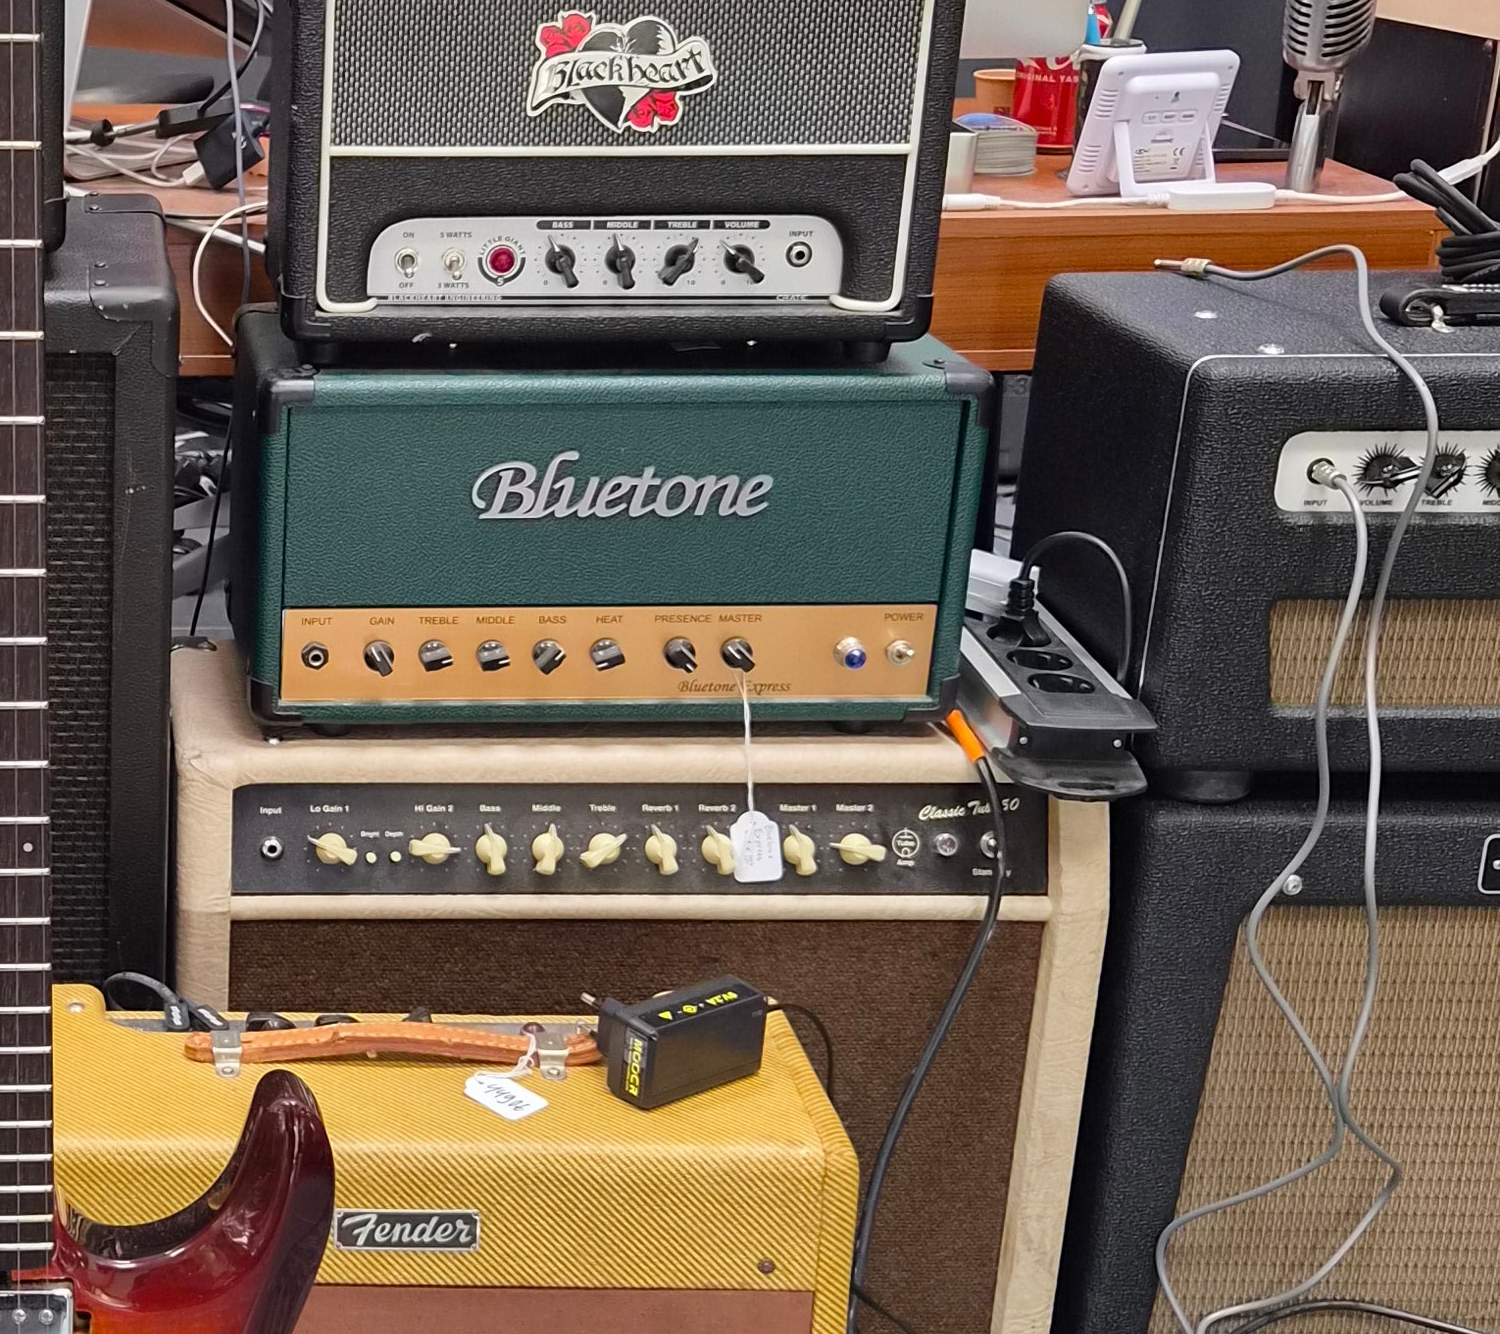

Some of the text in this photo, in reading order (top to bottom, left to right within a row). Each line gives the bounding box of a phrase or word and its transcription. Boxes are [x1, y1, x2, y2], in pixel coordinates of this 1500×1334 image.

[552, 48, 706, 93] Blackheart
[552, 221, 574, 229] BASS
[606, 221, 639, 229] MIDDLE
[667, 221, 698, 229] TREBLE
[724, 221, 760, 229] VOLUME
[403, 231, 415, 239] ON
[446, 231, 472, 239] WATTS
[788, 230, 814, 238] INPUT
[479, 235, 527, 256] LITTLE GIANT
[471, 450, 774, 519] Bluetone
[300, 617, 332, 626] INPUT
[369, 617, 395, 625] GAIN
[419, 616, 459, 625] TREBLE
[476, 616, 515, 625] MIDDLE
[538, 615, 567, 624] BASS
[596, 615, 623, 624] HEAT
[654, 614, 712, 623] PRESENCE
[719, 614, 762, 623] MASTER
[884, 612, 924, 622] POWER
[260, 806, 283, 816] Input
[322, 804, 341, 814] Gain
[425, 804, 444, 813] Gain
[480, 804, 501, 813] Bass
[532, 804, 561, 813] Middle
[589, 803, 616, 813] Treble
[642, 803, 671, 813] Reverb
[699, 803, 727, 813] Reverb
[779, 803, 809, 813] Master
[836, 803, 864, 813] Master
[918, 797, 1020, 821] Classic Tub 50
[341, 1214, 472, 1246] Fender
